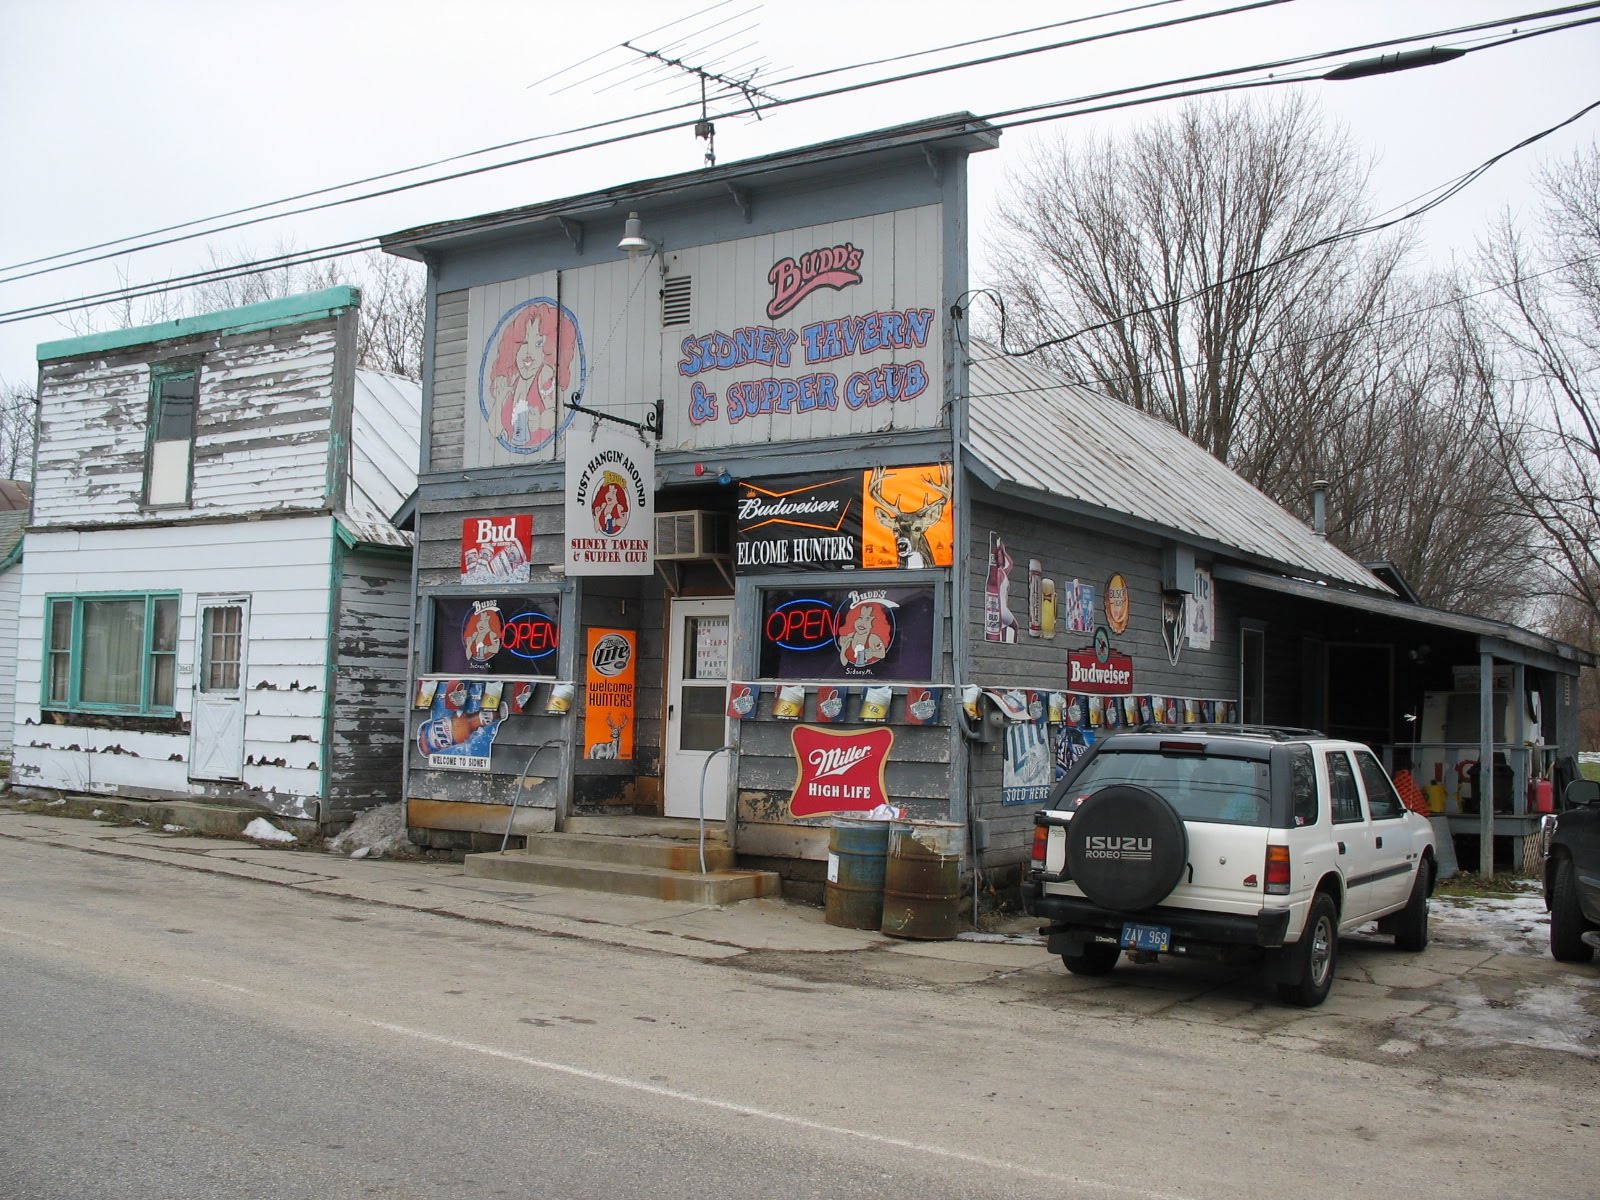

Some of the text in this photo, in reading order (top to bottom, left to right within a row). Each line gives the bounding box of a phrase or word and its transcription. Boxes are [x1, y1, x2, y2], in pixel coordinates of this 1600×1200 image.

[678, 308, 935, 376] SIDNEY TAVERN
[689, 360, 929, 425] & SUPPER CLUB
[577, 470, 592, 506] JUST
[622, 457, 646, 508] AROUND
[738, 496, 840, 520] Budweiser
[476, 517, 516, 543] Bud
[612, 539, 649, 550] TAVERN
[736, 540, 789, 566] ELCOME
[793, 536, 854, 563] HUNTERS
[584, 551, 621, 563] SUPPER
[624, 551, 648, 563] CLUB
[502, 622, 559, 649] OPEN
[766, 609, 841, 642] OPEN
[595, 646, 629, 667] Lite
[1071, 661, 1130, 685] Budweiser
[590, 680, 633, 693] welcome
[589, 693, 632, 708] HUNTERS
[432, 755, 488, 768] WELCOME TO SIDNEY
[808, 745, 872, 777] Miller
[808, 782, 871, 799] HIGH LIFE
[1006, 786, 1049, 802] SOLD HERE
[1085, 836, 1153, 851] ISUZU
[1085, 850, 1120, 859] RODEO
[1124, 927, 1143, 942] ZAV
[1149, 931, 1168, 945] 969
